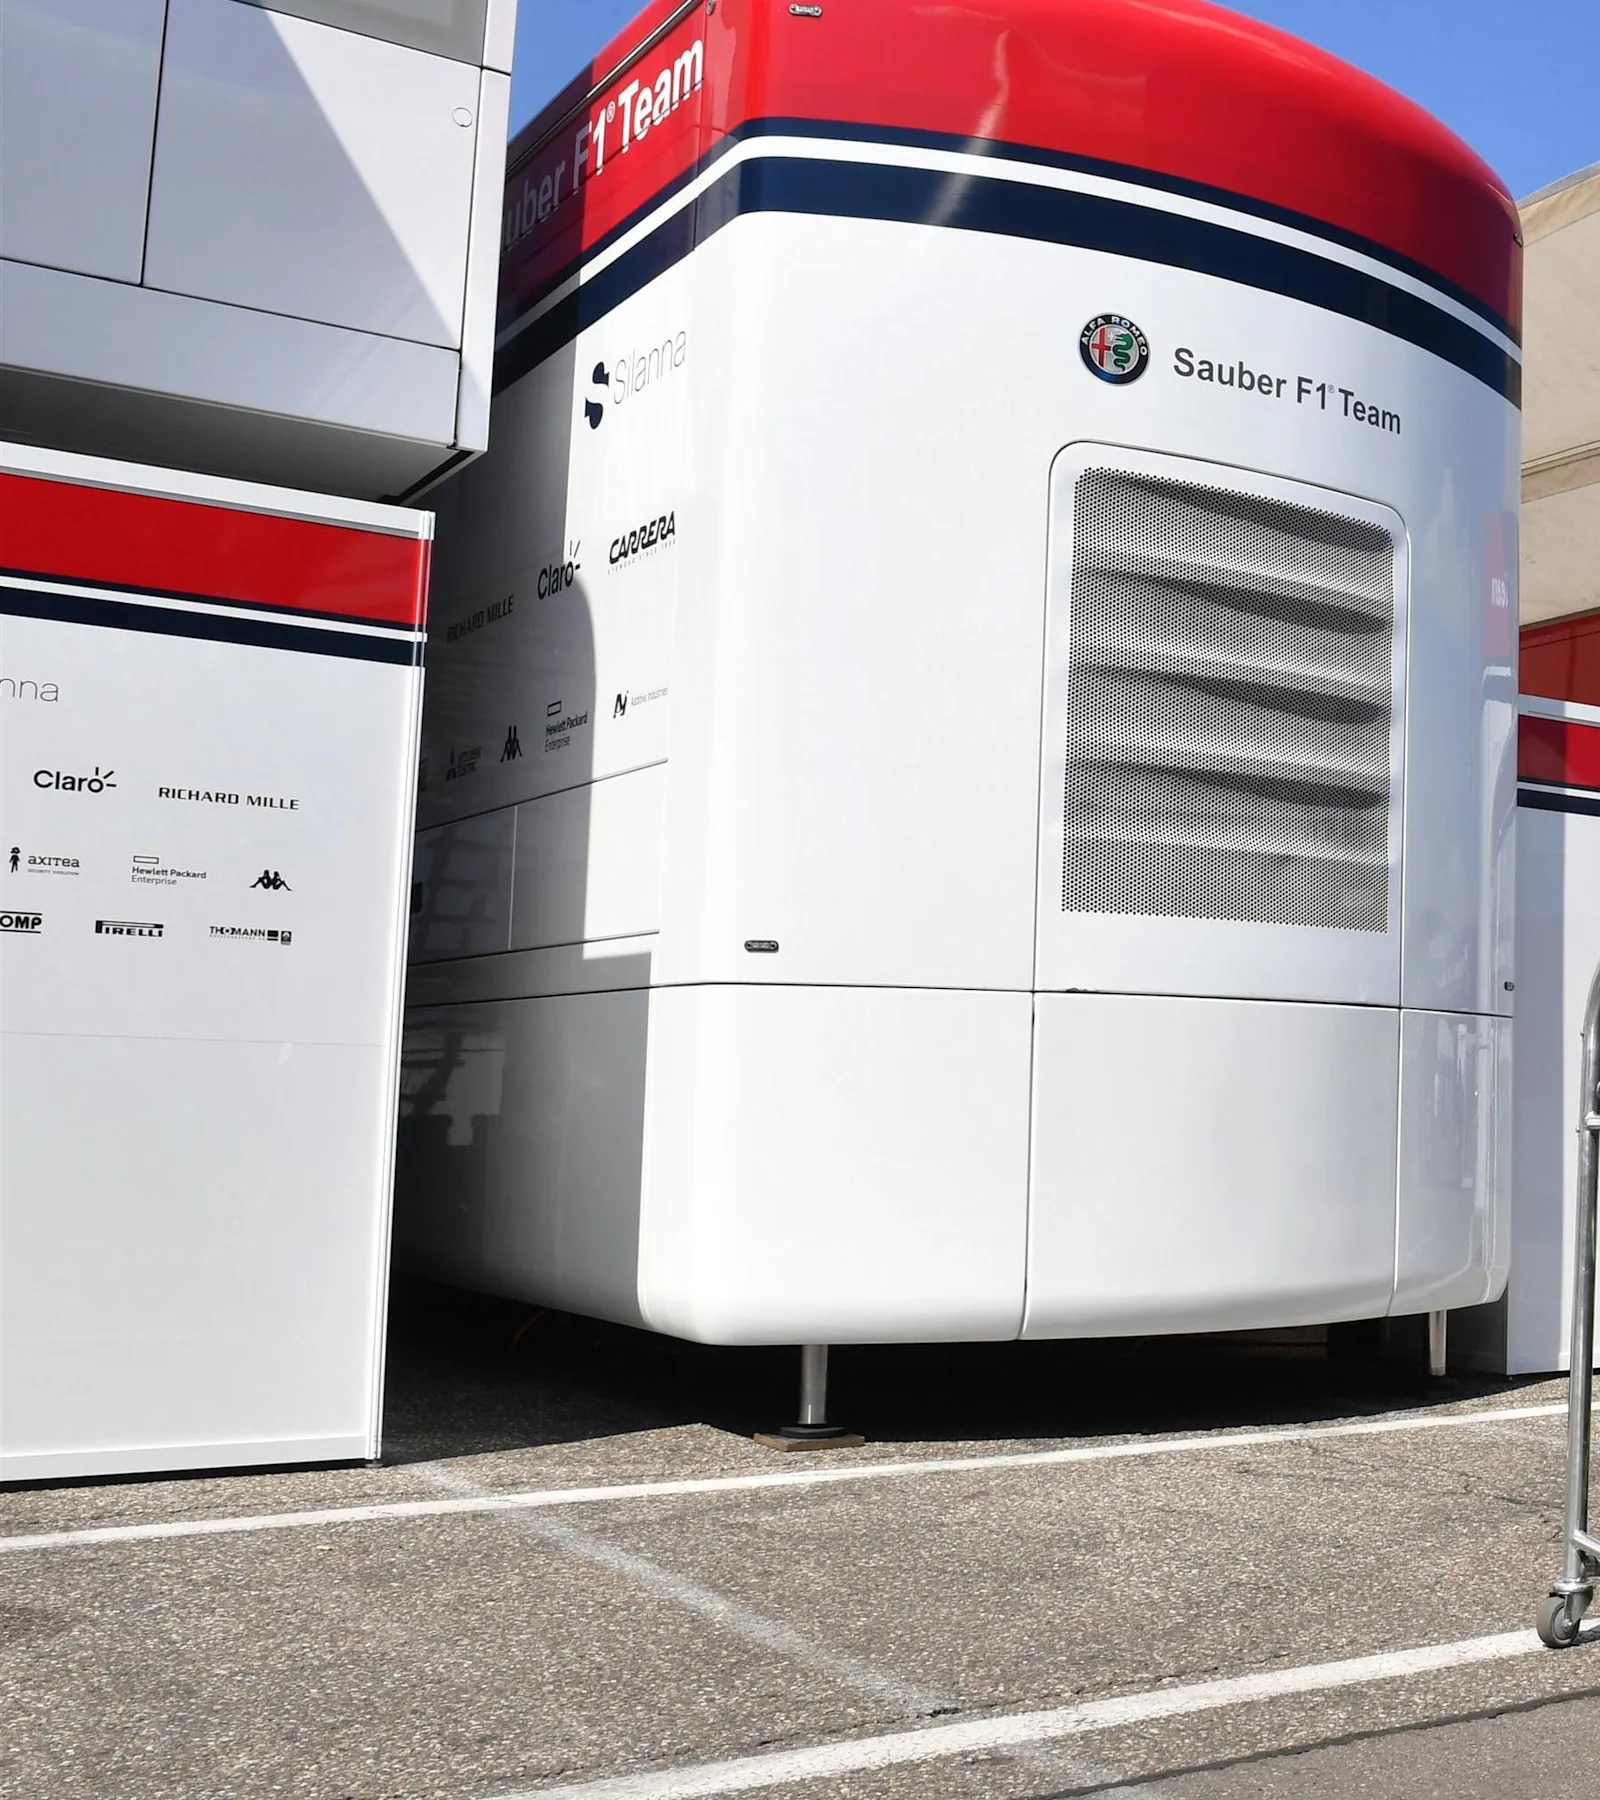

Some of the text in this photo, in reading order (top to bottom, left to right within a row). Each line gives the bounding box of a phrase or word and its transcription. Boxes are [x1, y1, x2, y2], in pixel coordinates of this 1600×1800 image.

[618, 39, 703, 154] Team
[1081, 316, 1148, 356] ALFA ROMEO
[614, 331, 686, 404] Silanna
[1173, 347, 1287, 398] Sauber
[1338, 387, 1401, 434] Team
[609, 511, 676, 564] CARRERA
[538, 548, 578, 600] Claro
[487, 595, 514, 624] MILLE
[34, 767, 117, 793] Claro
[158, 787, 299, 811] RICHARD MILLE
[131, 875, 177, 886] Enterprise
[132, 866, 207, 879] Hewlett Packard
[0, 915, 42, 929] OMP
[95, 920, 164, 937] PIRELLI
